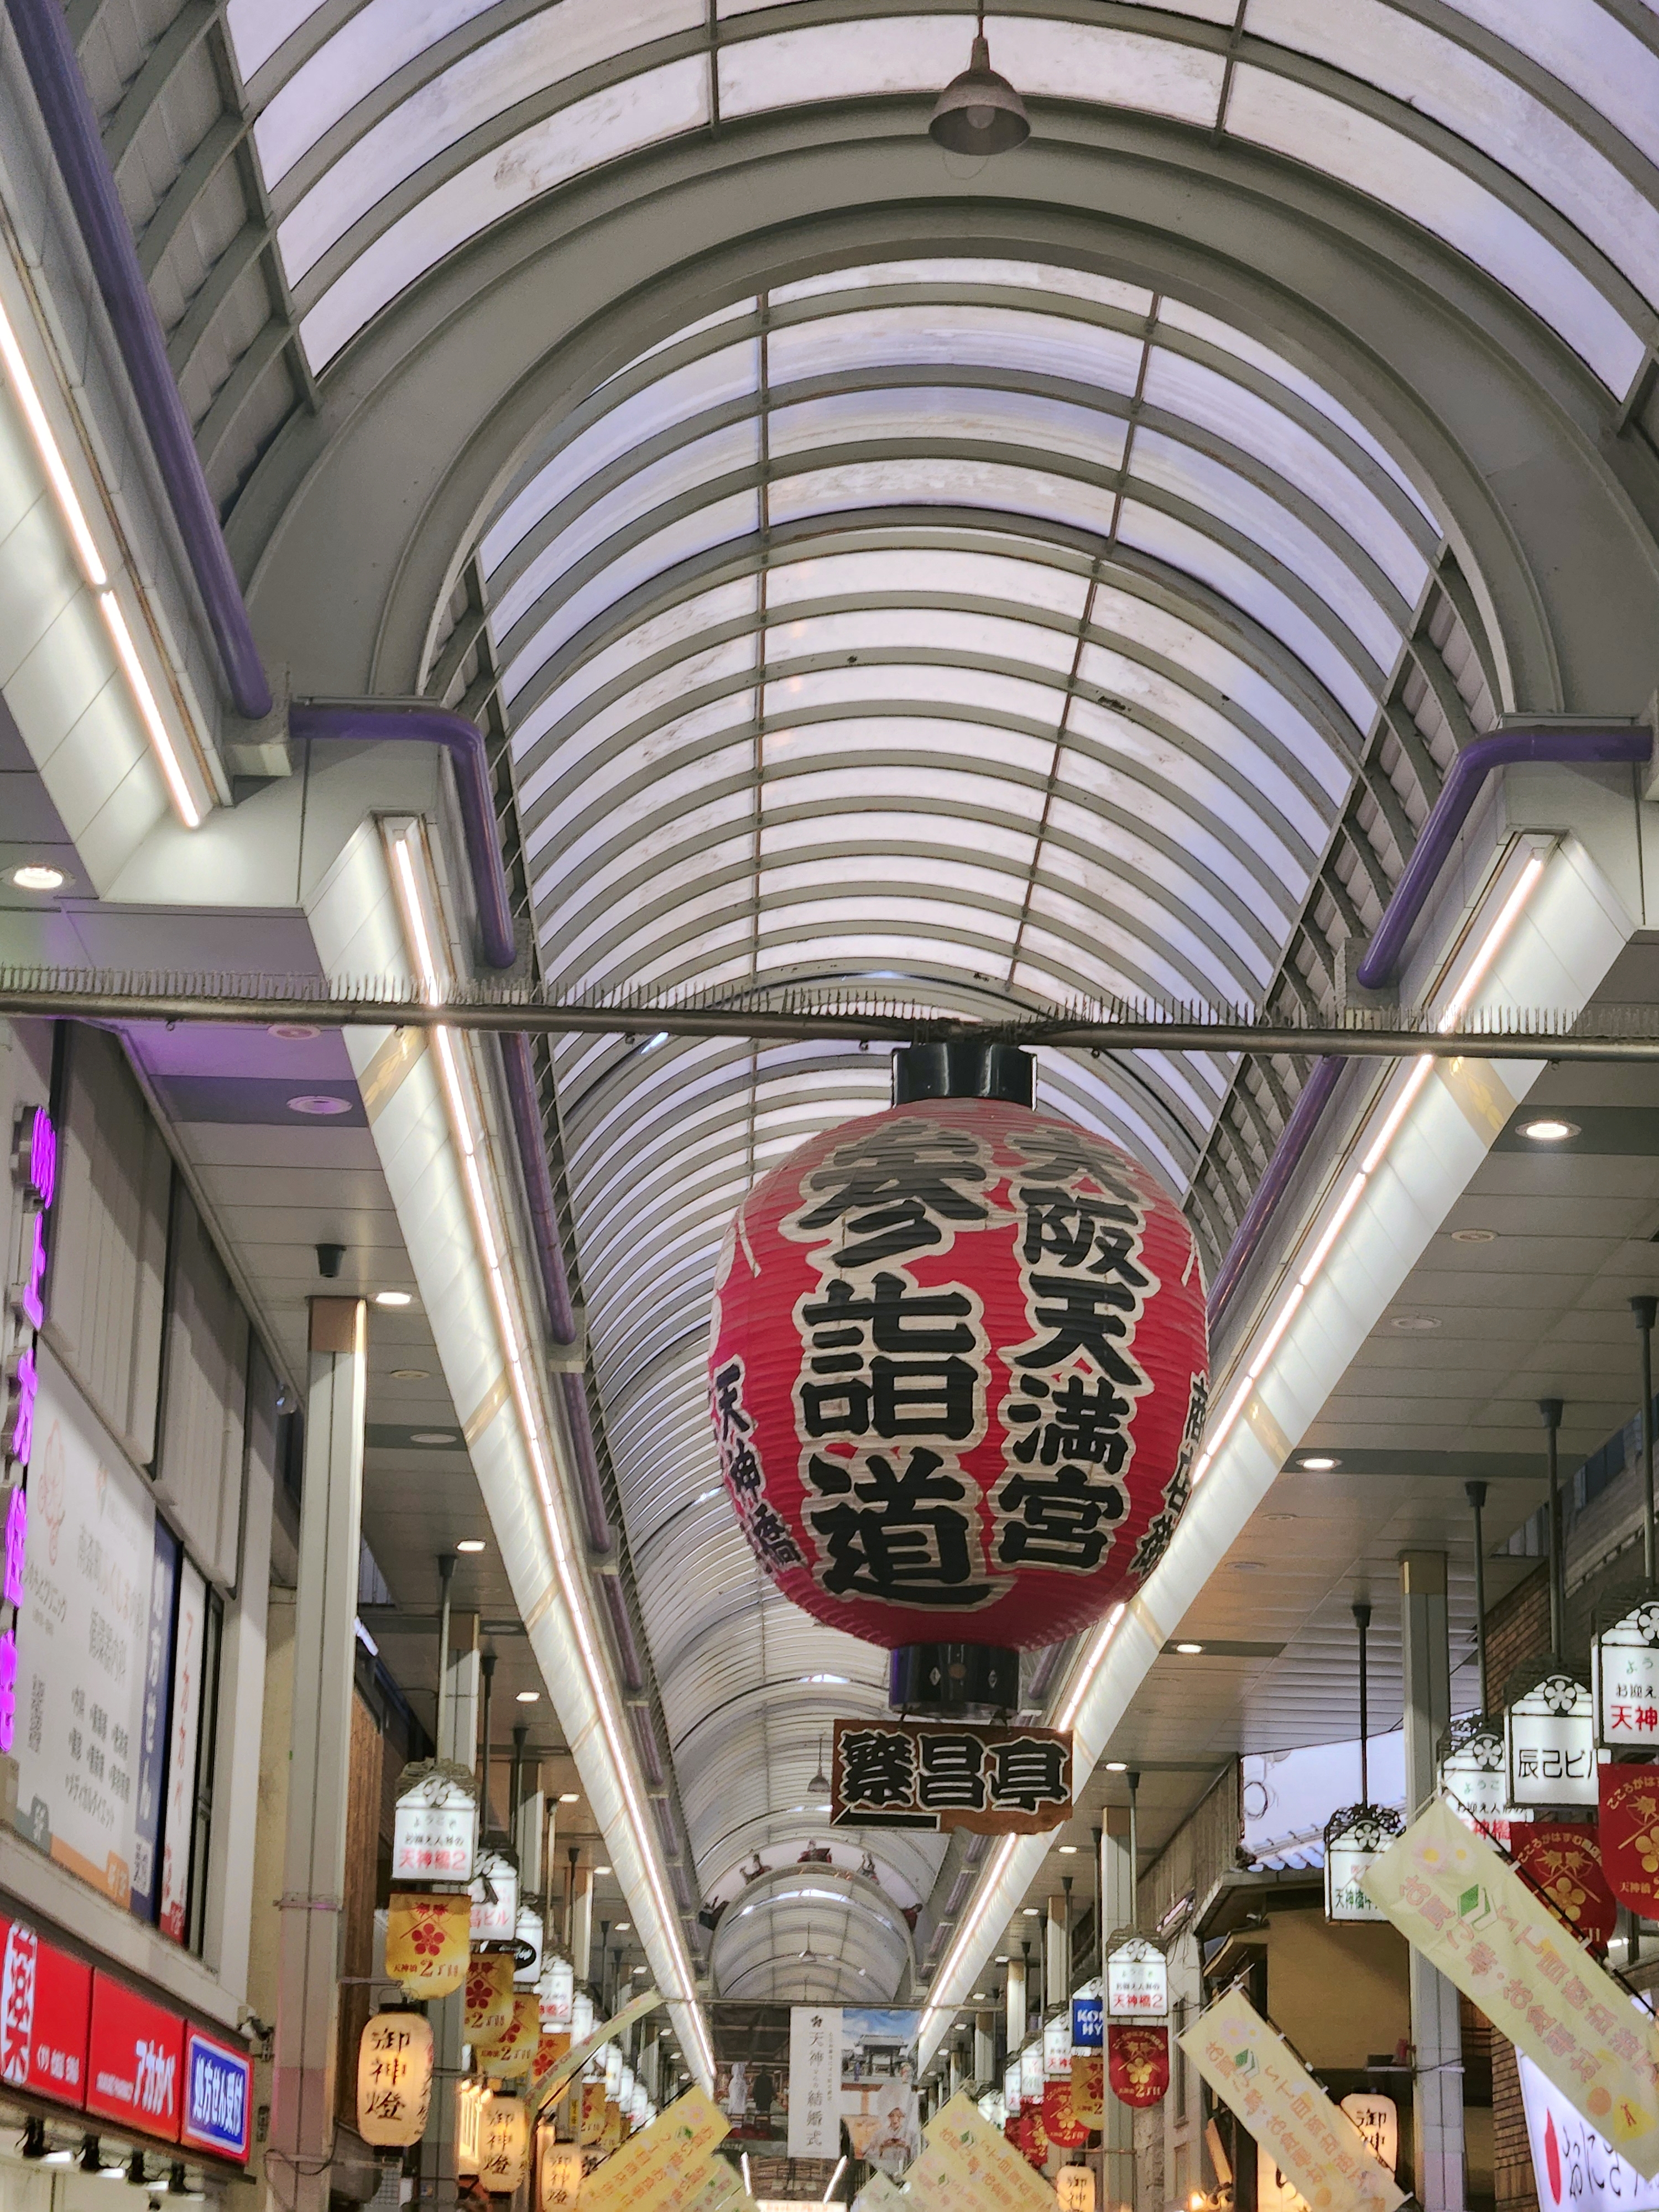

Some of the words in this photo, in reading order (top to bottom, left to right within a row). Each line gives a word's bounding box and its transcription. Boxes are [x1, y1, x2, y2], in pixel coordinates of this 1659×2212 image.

[799, 1119, 997, 1604] 参詣道
[998, 1127, 1148, 1568] 大阪天満宮
[839, 1729, 1071, 1815] 繁昌亭
[1606, 1776, 1659, 1810] こころがは
[399, 1849, 466, 1870] 天神橋2
[1113, 1994, 1163, 2008] 天神橋2
[133, 2038, 176, 2118] アカカベ
[192, 2053, 243, 2137] 処方せん受付
[365, 2027, 411, 2121] 御神燈
[483, 2109, 514, 2176] 御神燈
